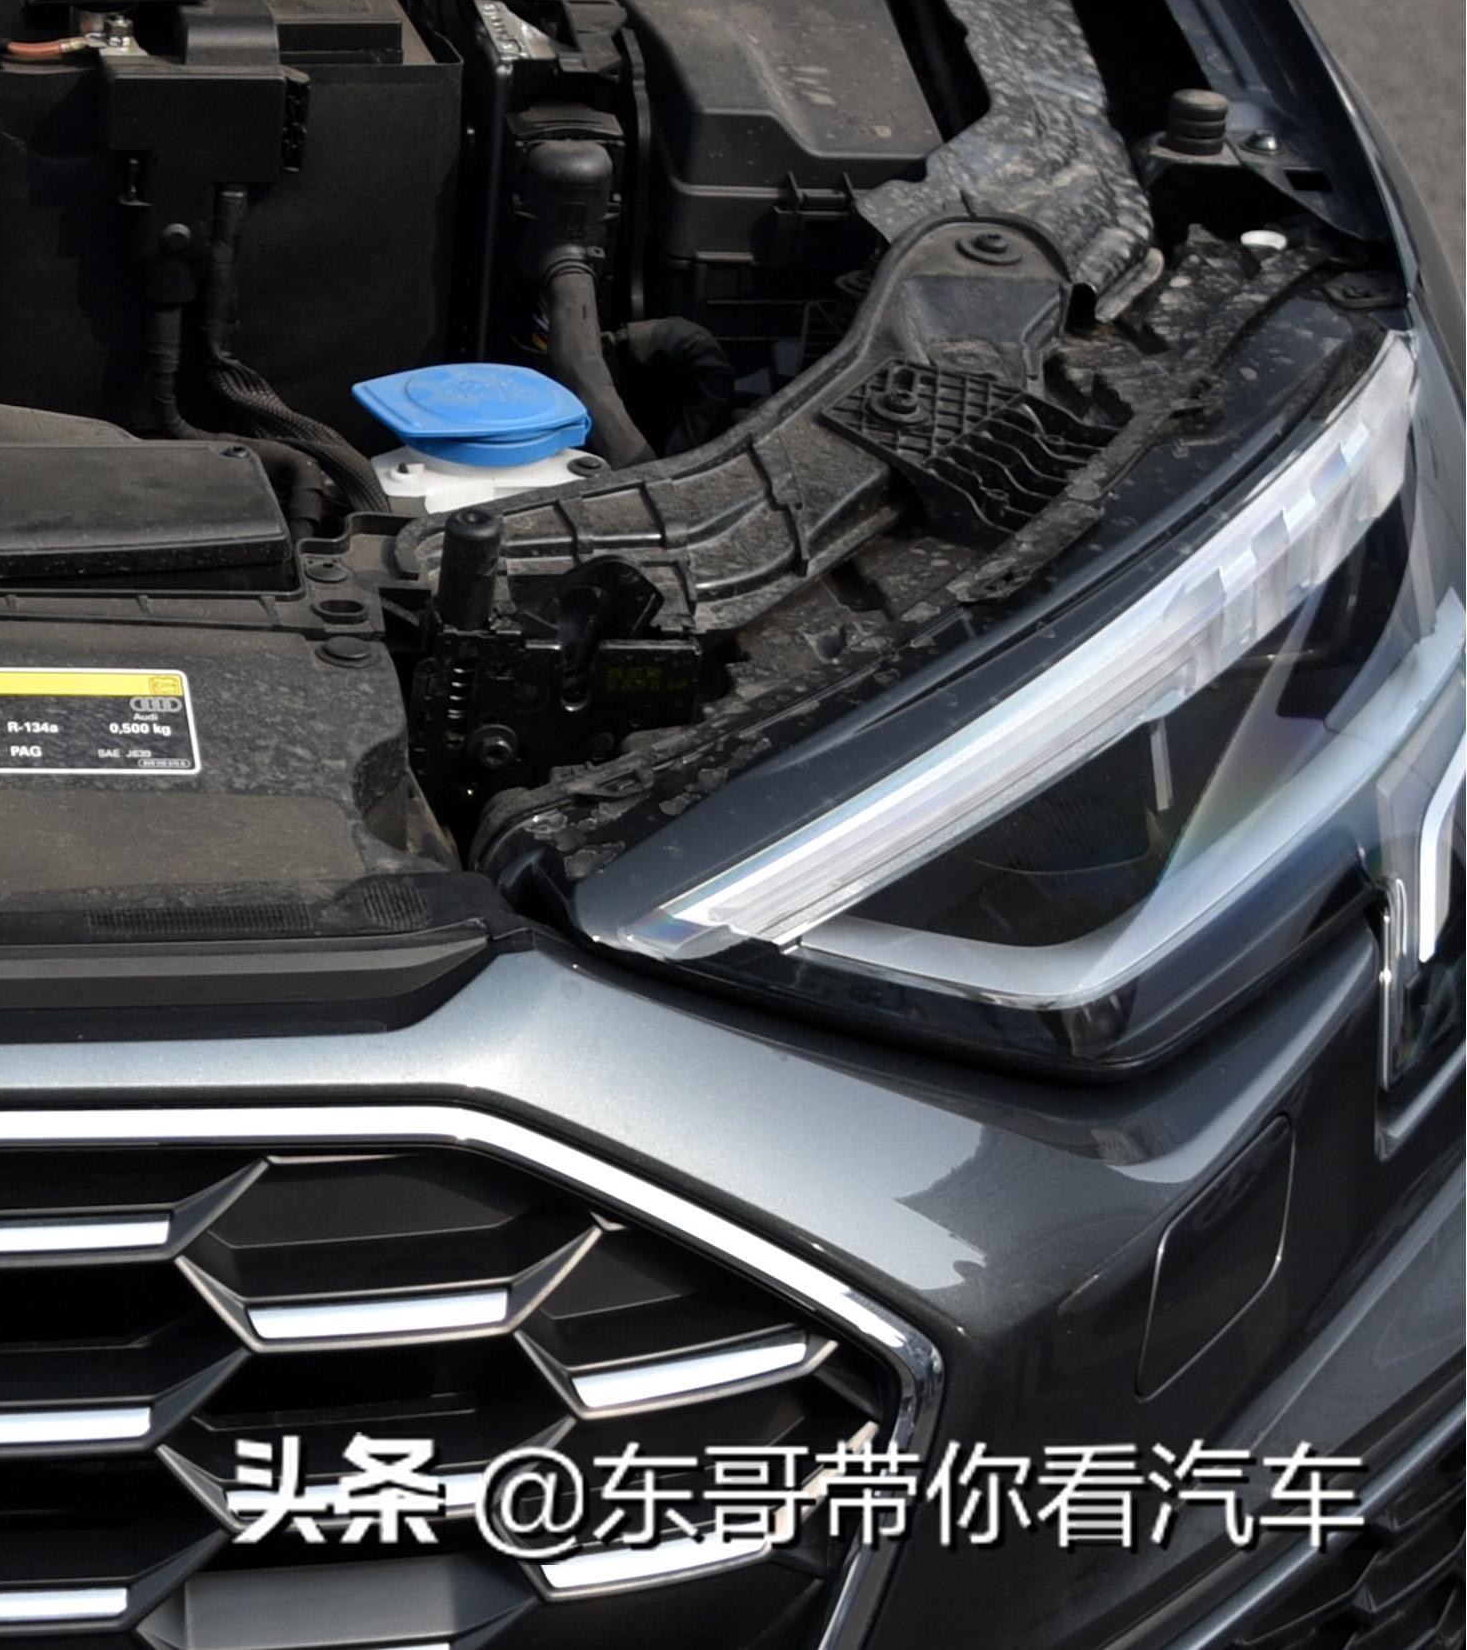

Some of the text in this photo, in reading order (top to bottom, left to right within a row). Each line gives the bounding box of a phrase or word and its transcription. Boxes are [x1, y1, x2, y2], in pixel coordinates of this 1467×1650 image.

[133, 712, 159, 721] Audi
[7, 722, 172, 737] R-134a 0,500 kg
[10, 746, 43, 758] PAG
